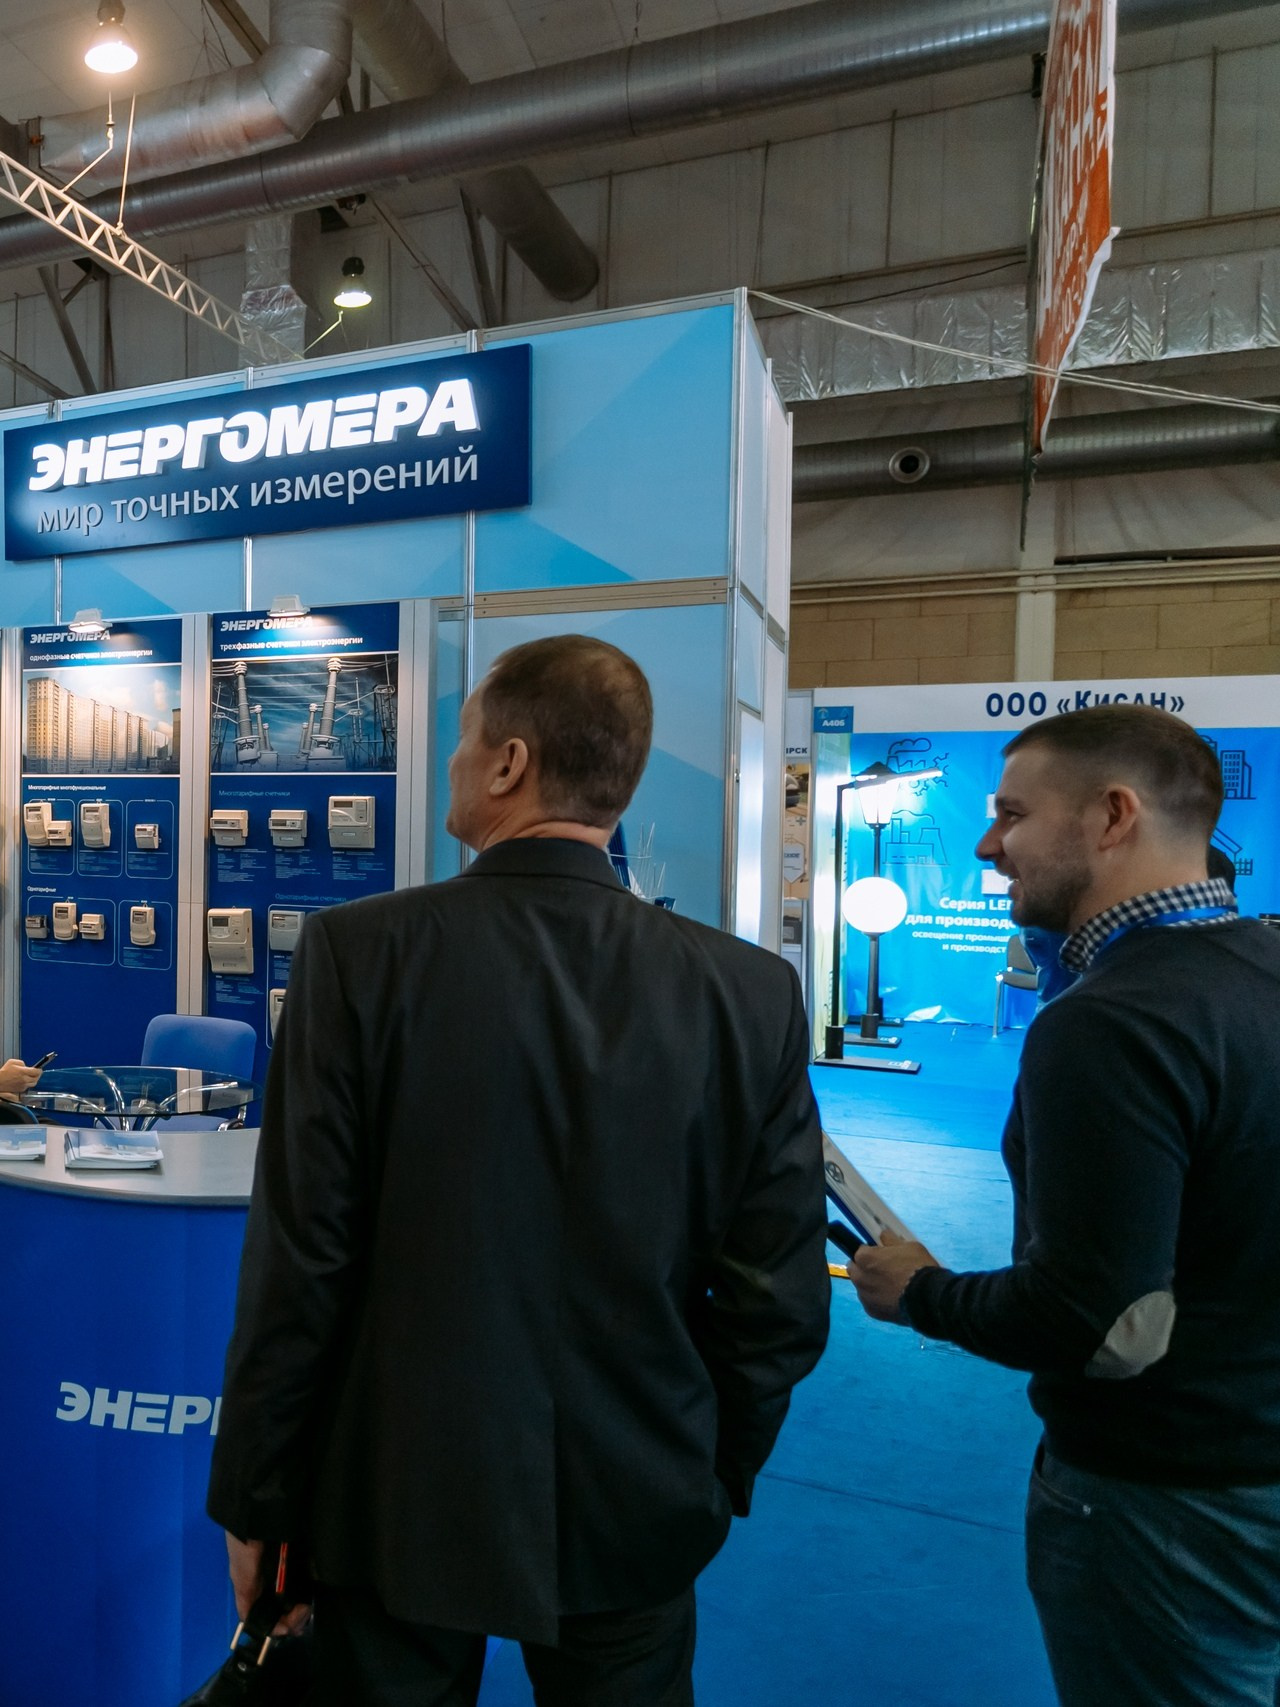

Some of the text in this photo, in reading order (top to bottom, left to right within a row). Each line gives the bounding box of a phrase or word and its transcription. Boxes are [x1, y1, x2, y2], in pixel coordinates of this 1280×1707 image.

[28, 378, 482, 492] ЭНЕРГОМЕРА
[36, 444, 479, 536] мир точных измерений
[220, 616, 314, 632] ЭНЕРГОМЕРА
[29, 630, 111, 644] ЭНЕРГОМЕРА
[986, 691, 1047, 718] ООО
[939, 896, 986, 912] Серия
[904, 914, 933, 925] для
